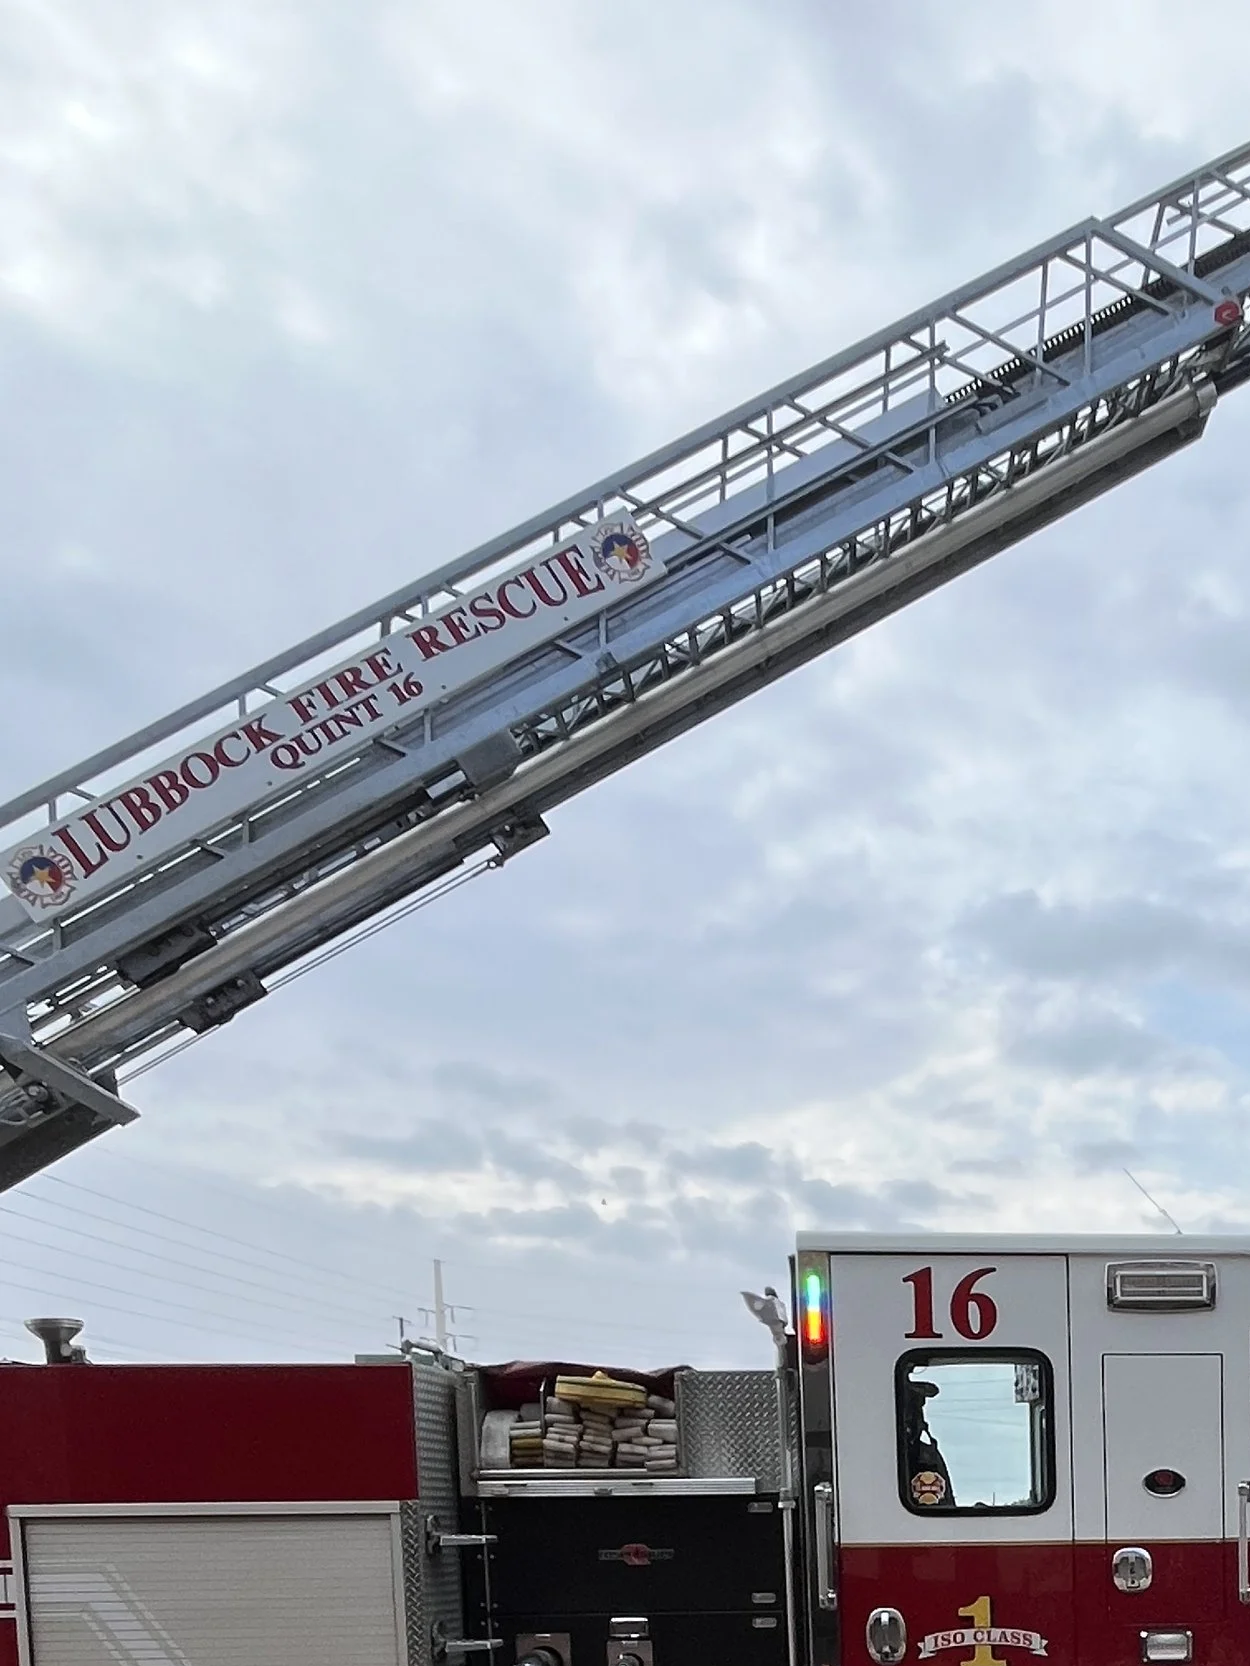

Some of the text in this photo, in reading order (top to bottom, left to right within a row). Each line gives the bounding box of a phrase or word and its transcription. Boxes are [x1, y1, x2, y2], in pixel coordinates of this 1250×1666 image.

[51, 543, 605, 879] LUBBOCK FIRE RESCUE
[268, 671, 424, 771] QUINT 16
[902, 1266, 998, 1340] 16
[932, 1629, 1034, 1647] ISO CLASS
